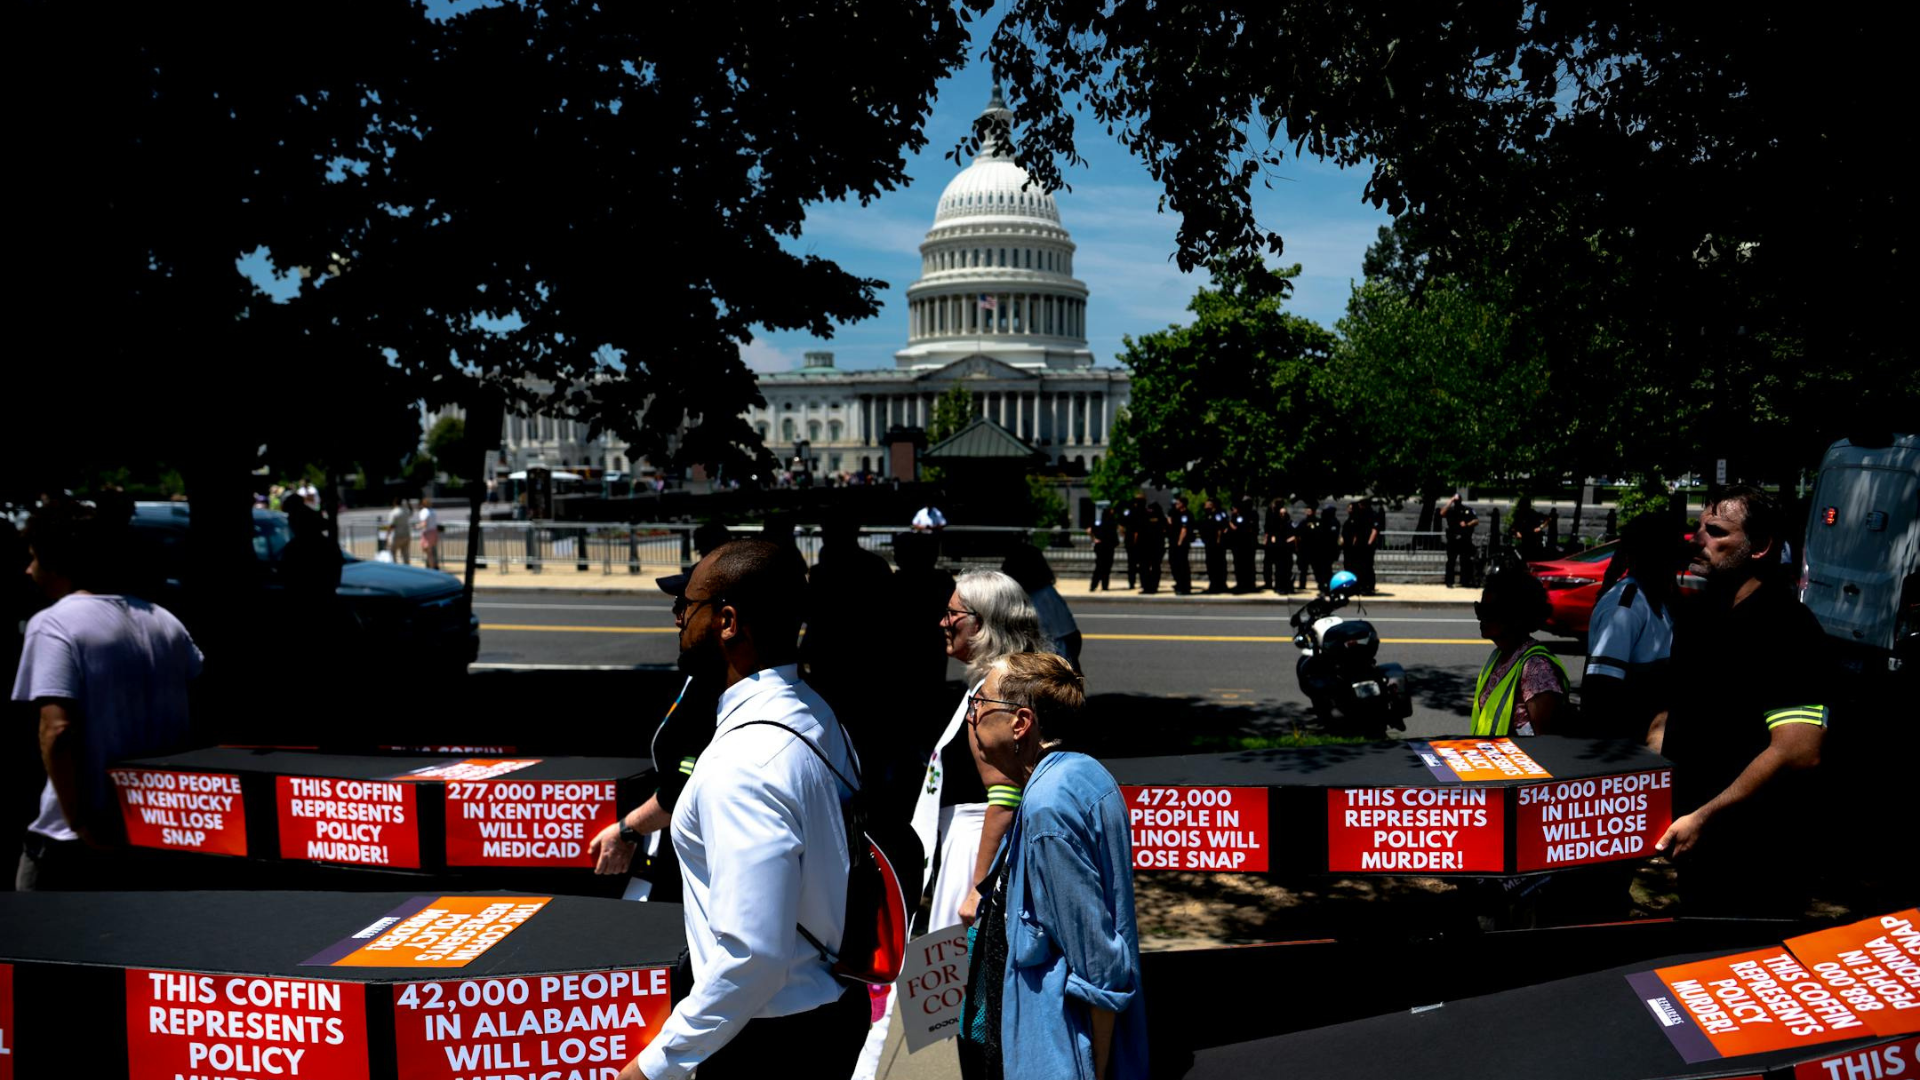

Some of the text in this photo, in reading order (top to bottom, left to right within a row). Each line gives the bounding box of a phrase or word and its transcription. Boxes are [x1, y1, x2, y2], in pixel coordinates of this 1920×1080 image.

[1510, 754, 1547, 775] COFFIN
[111, 772, 241, 794] 135,000 PEOPLE
[290, 778, 402, 802] THIS COFFIN
[448, 783, 616, 802] 277,000 PEOPLE
[1519, 771, 1671, 805] 514,000 PEOPLE
[126, 789, 233, 812] IN KENTUCKY
[291, 799, 405, 824] REPRESENTS
[463, 803, 600, 820] IN KENTUCKY
[1136, 789, 1232, 809] 472,000
[1345, 789, 1486, 806] THIS COFFIN
[1542, 794, 1648, 822] IN ILLINOIS
[140, 808, 224, 830] WILL LOSE
[316, 821, 382, 842] POLICY
[479, 822, 584, 839] WILL LOSE
[1131, 809, 1239, 827] PEOPLE IN
[1345, 809, 1488, 827] REPRESENTS
[1542, 814, 1647, 842] WILL LOSE
[162, 828, 205, 846] SNAP
[483, 841, 581, 858] MEDICAID
[1131, 829, 1260, 848] LINOIS WILL
[1374, 830, 1458, 848] POLICY
[1546, 835, 1644, 863] MEDICAID
[307, 841, 389, 864] MURDER!
[1132, 850, 1246, 869] OSE SNAP
[1361, 851, 1464, 869] MURDER!
[365, 908, 449, 950] MURDER!
[404, 913, 472, 949] POLICY
[414, 903, 515, 962] REPRESENTS
[446, 902, 544, 961] THIS COFFIN
[924, 936, 968, 966] IT'S
[148, 972, 341, 1011] THIS COFFIN
[397, 969, 666, 1012] 42,000 PEOPLE
[907, 964, 959, 999] FOR
[1763, 953, 1864, 1031] THIS COFFIN
[1813, 962, 1885, 1011] 888,000
[1837, 949, 1920, 1010] PEOPLE IN
[923, 985, 967, 1015] CO
[1671, 979, 1740, 1035] MURDER!
[1708, 978, 1773, 1025] POLICY
[1729, 960, 1824, 1036] REPRESENTS
[149, 1006, 344, 1045] REPRESENTS
[425, 1002, 646, 1041] IN ALABAMA
[189, 1042, 305, 1075] POLICY
[445, 1035, 627, 1072] WILL LOSE
[1821, 1046, 1905, 1080] THIS
